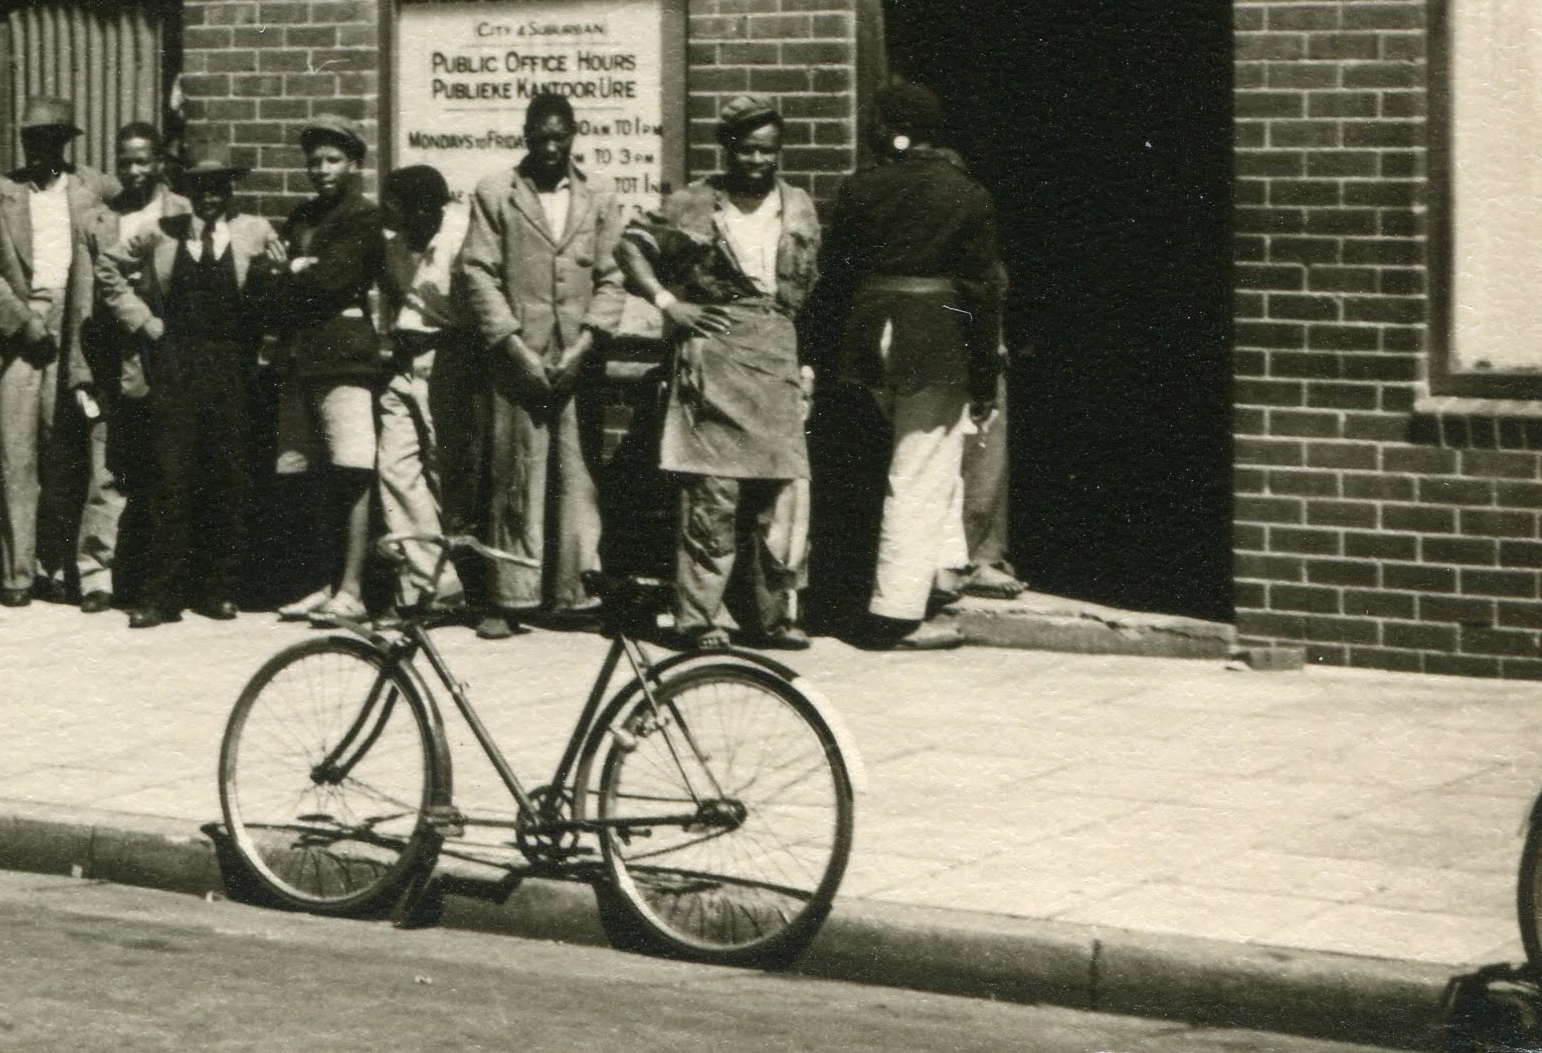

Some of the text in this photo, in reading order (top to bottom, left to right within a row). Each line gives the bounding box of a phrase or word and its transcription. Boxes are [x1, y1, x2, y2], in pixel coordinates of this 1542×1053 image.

[527, 21, 604, 37] SUBURBAN
[431, 50, 637, 74] PUBLIC OFFICE HOURS
[431, 78, 512, 100] PUBLIEKE
[487, 130, 525, 149] FRIDA
